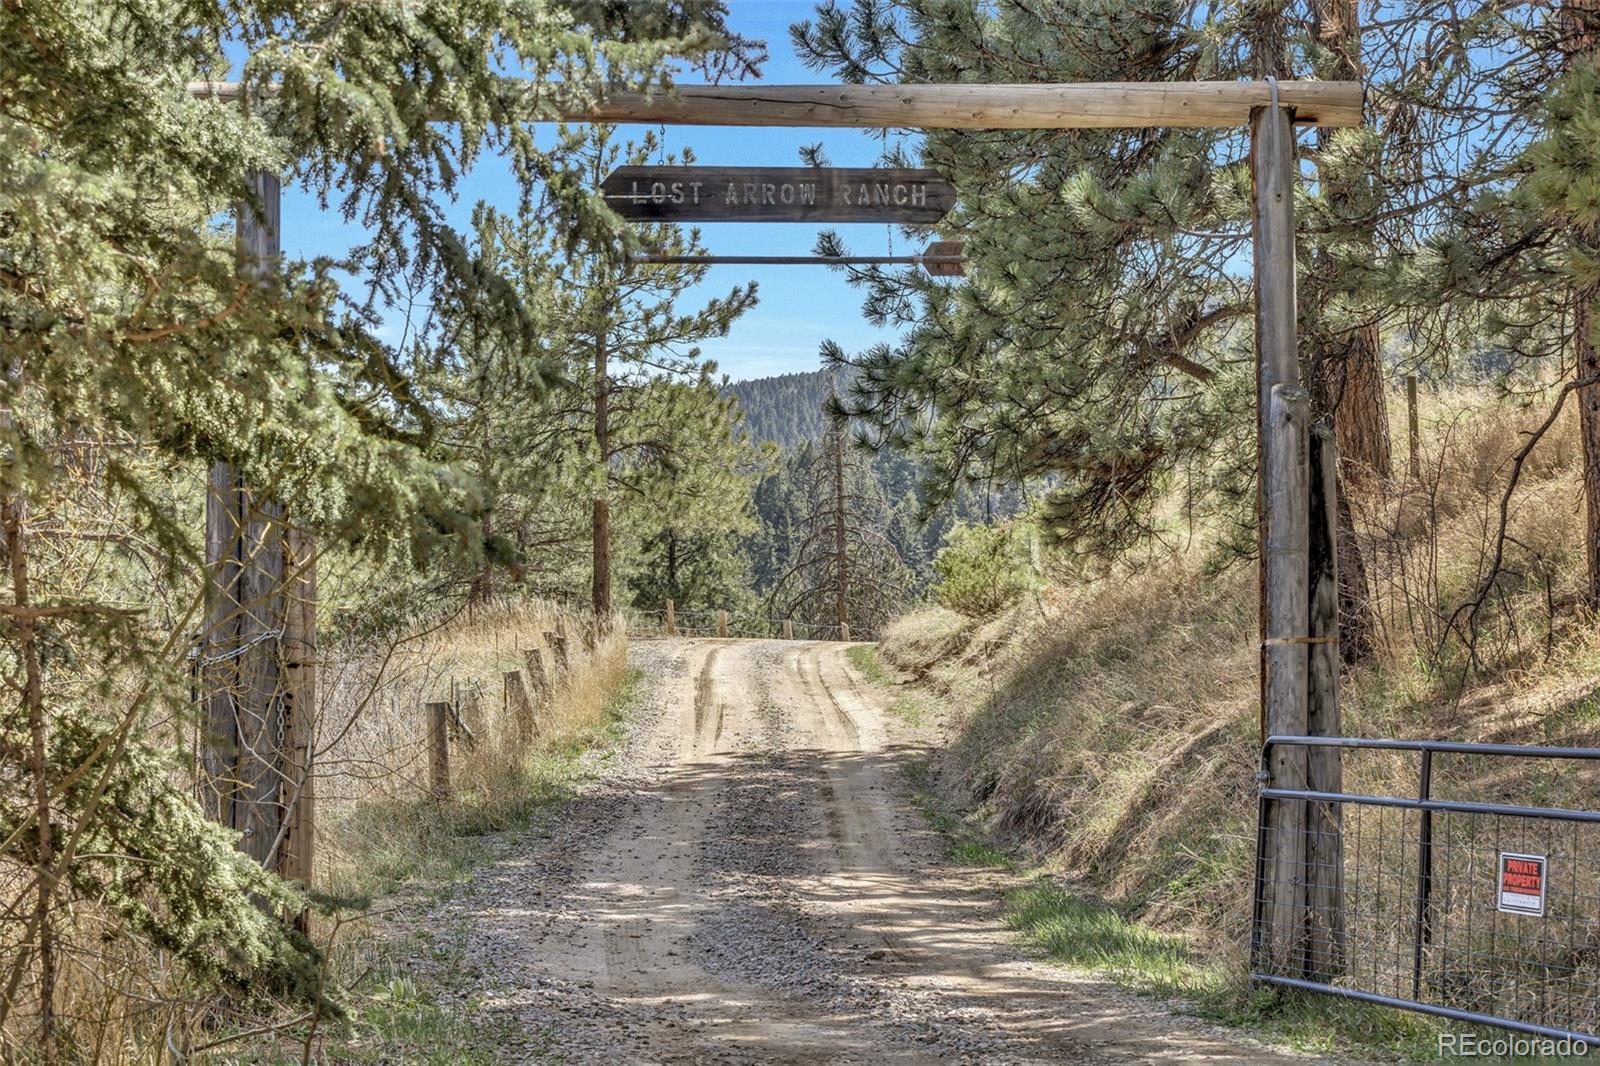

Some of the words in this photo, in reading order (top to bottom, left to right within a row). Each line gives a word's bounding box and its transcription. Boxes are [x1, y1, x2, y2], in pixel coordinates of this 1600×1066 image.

[631, 181, 703, 205] LOST
[725, 182, 816, 205] ARROW
[839, 183, 926, 206] RANCH
[1507, 860, 1538, 874] PRIVATE
[1503, 872, 1541, 888] PROPERTY
